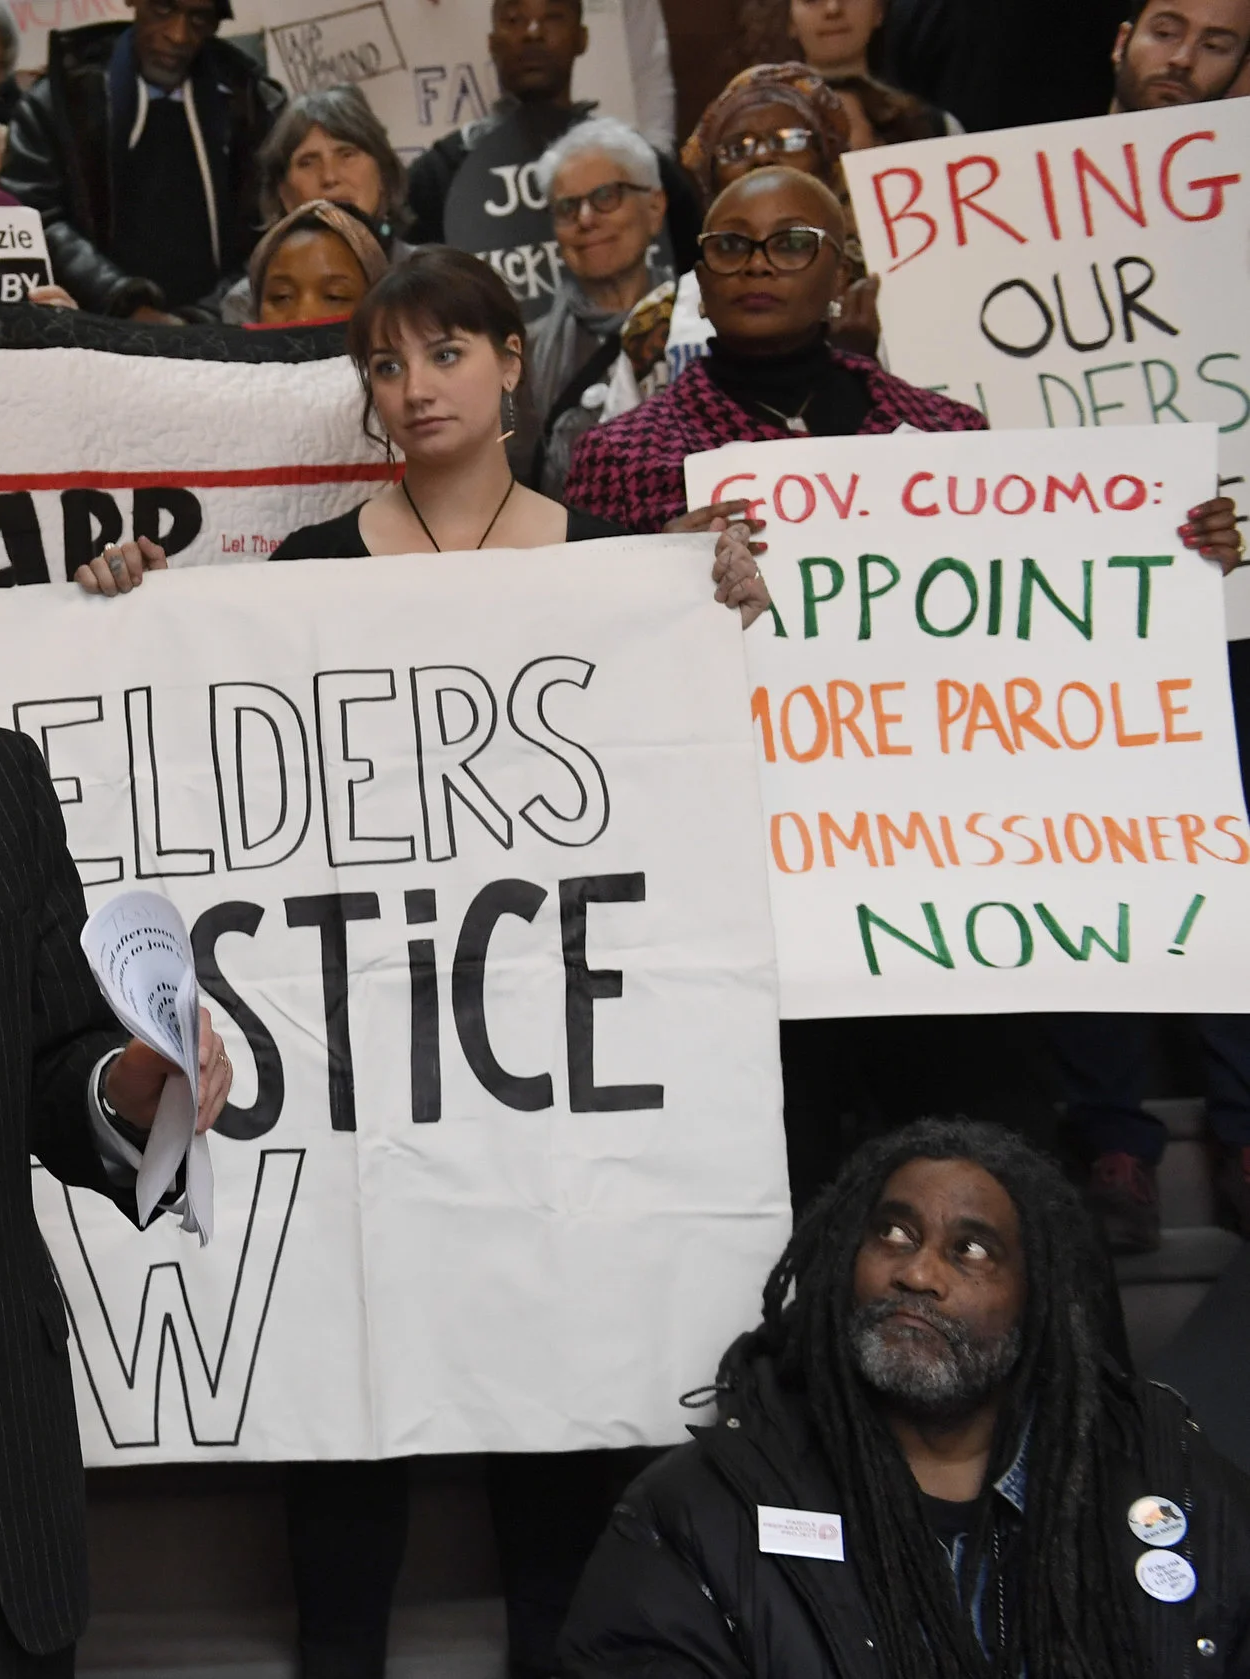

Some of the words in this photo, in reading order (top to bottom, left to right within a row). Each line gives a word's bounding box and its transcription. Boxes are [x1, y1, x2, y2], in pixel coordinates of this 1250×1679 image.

[871, 130, 1241, 273] BRING
[979, 255, 1180, 358] OUR
[901, 470, 1164, 519] CUOMO:
[251, 534, 285, 553] The
[936, 677, 1203, 756] PAROLE
[770, 811, 1250, 875] OMMISSIONERS
